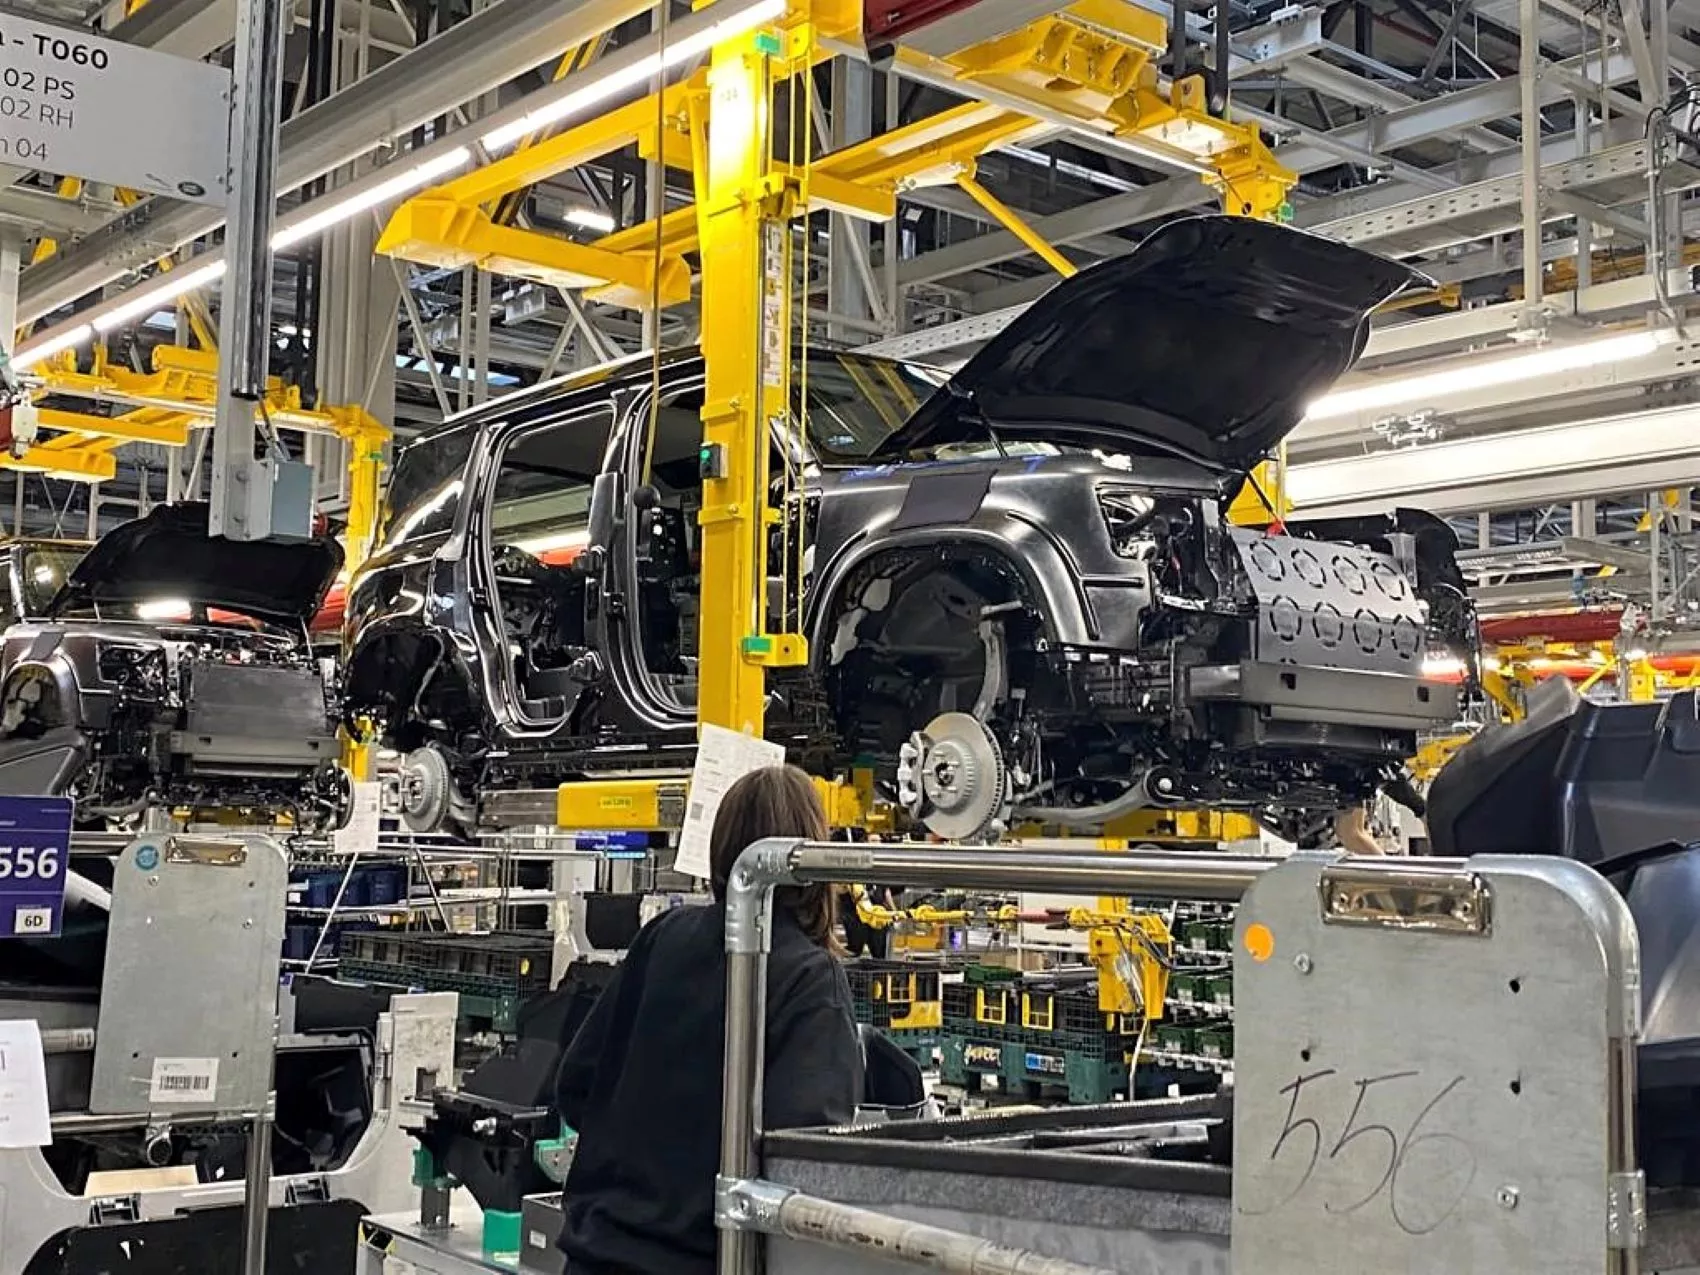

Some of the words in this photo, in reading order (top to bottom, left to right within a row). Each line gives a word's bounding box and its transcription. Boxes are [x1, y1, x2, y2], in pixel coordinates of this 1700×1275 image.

[33, 34, 108, 69] T060
[4, 68, 35, 92] 02
[44, 76, 75, 100] PS
[1, 96, 31, 120] 02
[40, 104, 73, 129] RH
[16, 138, 48, 161] 04
[1238, 1069, 1477, 1235] 556
